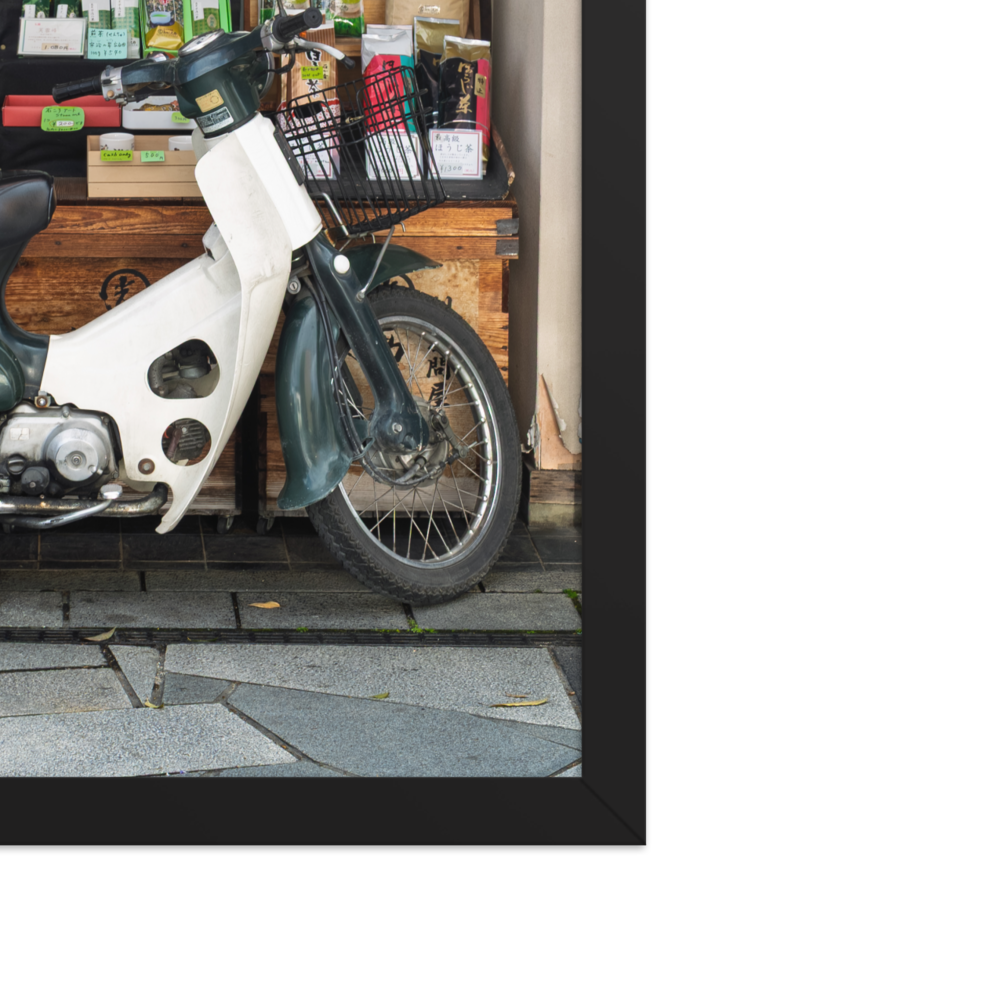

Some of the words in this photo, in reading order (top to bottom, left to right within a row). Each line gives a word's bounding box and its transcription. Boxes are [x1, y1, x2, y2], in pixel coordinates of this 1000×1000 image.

[456, 62, 473, 114] ほうじ茶
[435, 143, 474, 154] ほうじ茶
[440, 164, 463, 173] ¥1300
